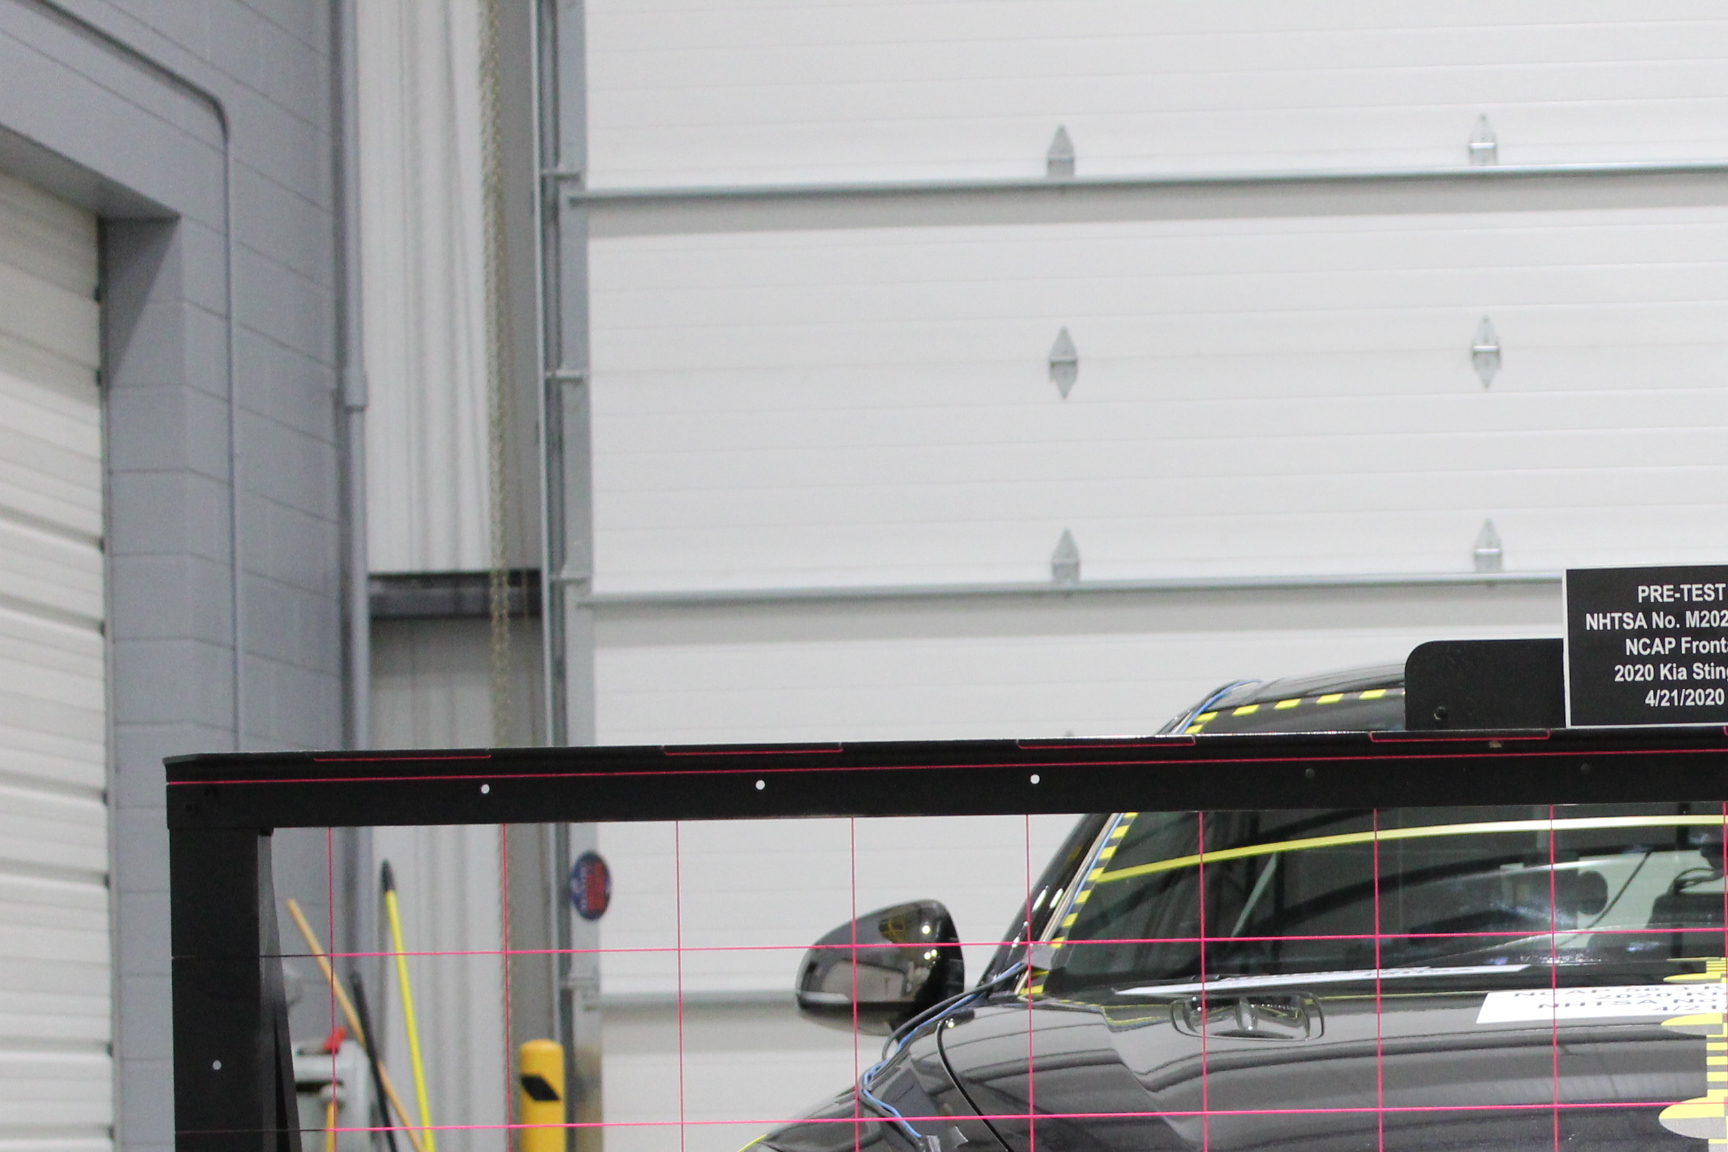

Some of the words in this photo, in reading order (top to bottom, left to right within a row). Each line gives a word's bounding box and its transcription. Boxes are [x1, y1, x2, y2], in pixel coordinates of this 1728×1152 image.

[1637, 583, 1726, 603] PRE-TEST
[1585, 612, 1648, 630] NHTSA
[1652, 611, 1680, 629] No.
[1625, 637, 1676, 655] NCAP
[1614, 664, 1654, 682] 2020
[1660, 663, 1687, 680] Kia
[1645, 688, 1725, 707] 4/21/2020
